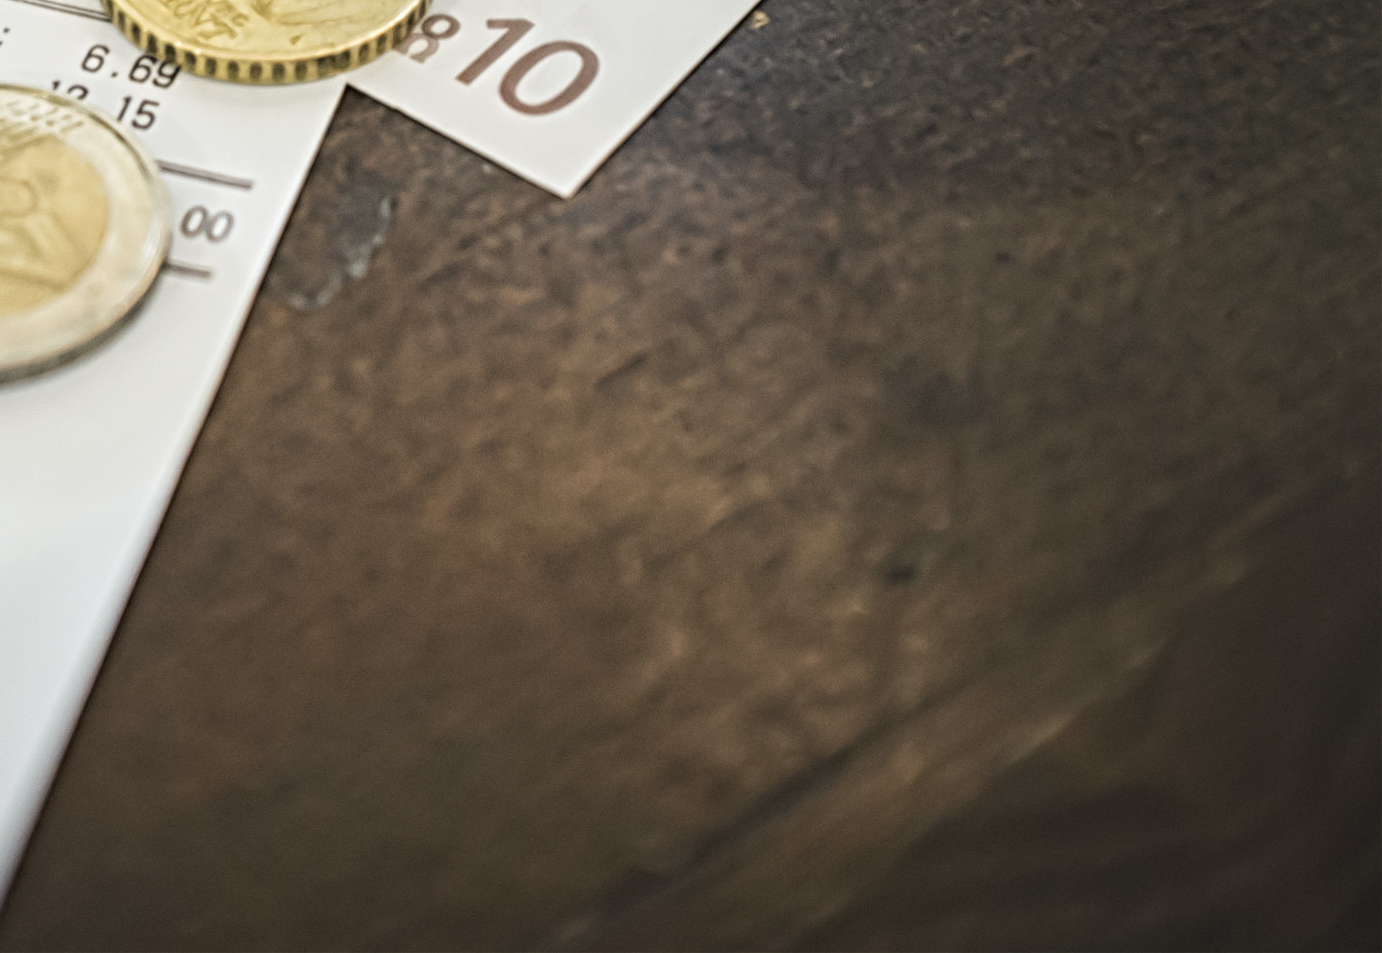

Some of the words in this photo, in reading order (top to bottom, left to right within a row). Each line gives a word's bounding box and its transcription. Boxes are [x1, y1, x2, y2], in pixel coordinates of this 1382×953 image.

[81, 45, 182, 89] 6.69
[454, 17, 601, 117] 10
[179, 205, 235, 243] 00
